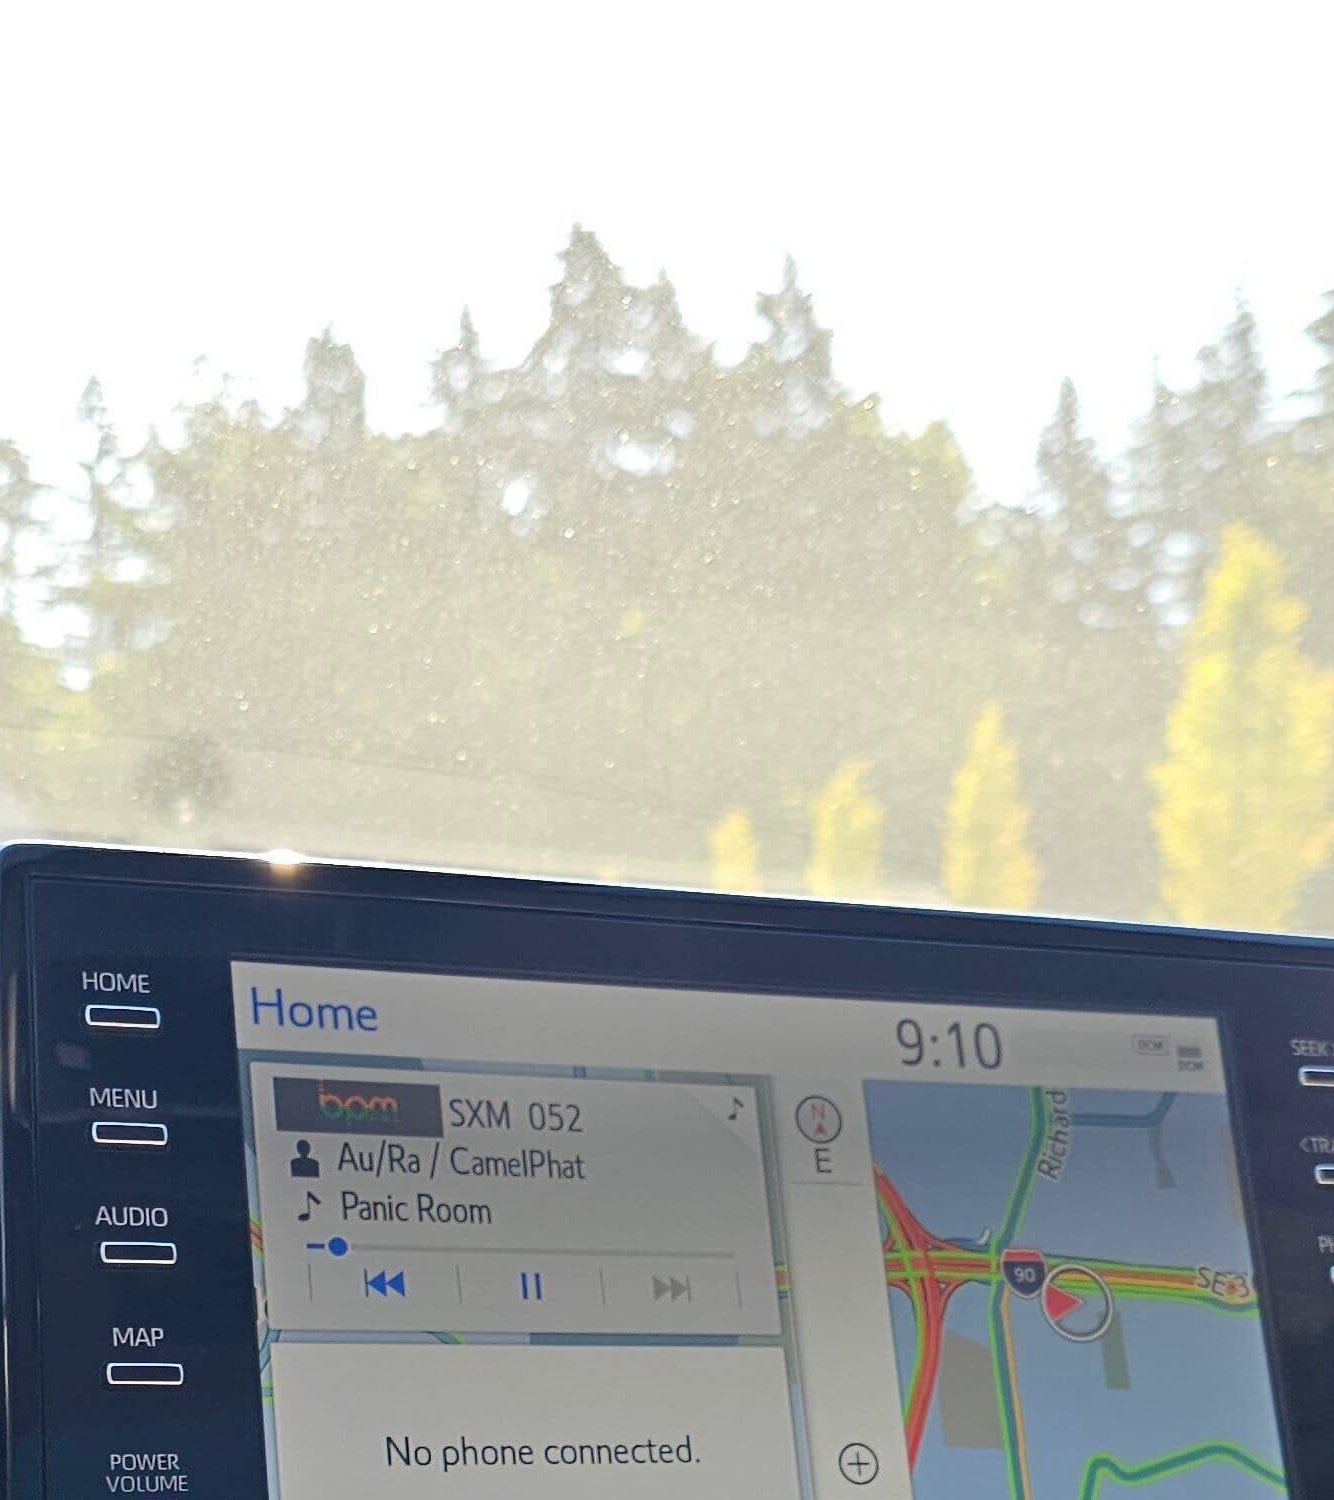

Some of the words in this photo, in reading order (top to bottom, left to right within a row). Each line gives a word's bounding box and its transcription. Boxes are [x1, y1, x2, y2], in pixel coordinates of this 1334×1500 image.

[82, 972, 150, 994] HOME
[250, 986, 378, 1032] Home
[896, 1018, 1003, 1070] 9:10
[90, 1088, 157, 1109] MENU
[449, 1099, 510, 1130] SXM
[529, 1102, 584, 1133] 052
[337, 1140, 420, 1178] Au/Ra
[450, 1147, 586, 1179] CamelPhat
[814, 1148, 832, 1173] E
[95, 1206, 168, 1229] AUDIO
[341, 1192, 407, 1224] Panic
[415, 1196, 492, 1226] Room
[1014, 1266, 1036, 1285] 90
[112, 1326, 164, 1347] MAP
[110, 1453, 180, 1472] POWER
[385, 1436, 432, 1467] No
[442, 1435, 534, 1472] phone
[544, 1435, 701, 1467] connected.
[106, 1475, 188, 1494] VOLUME
